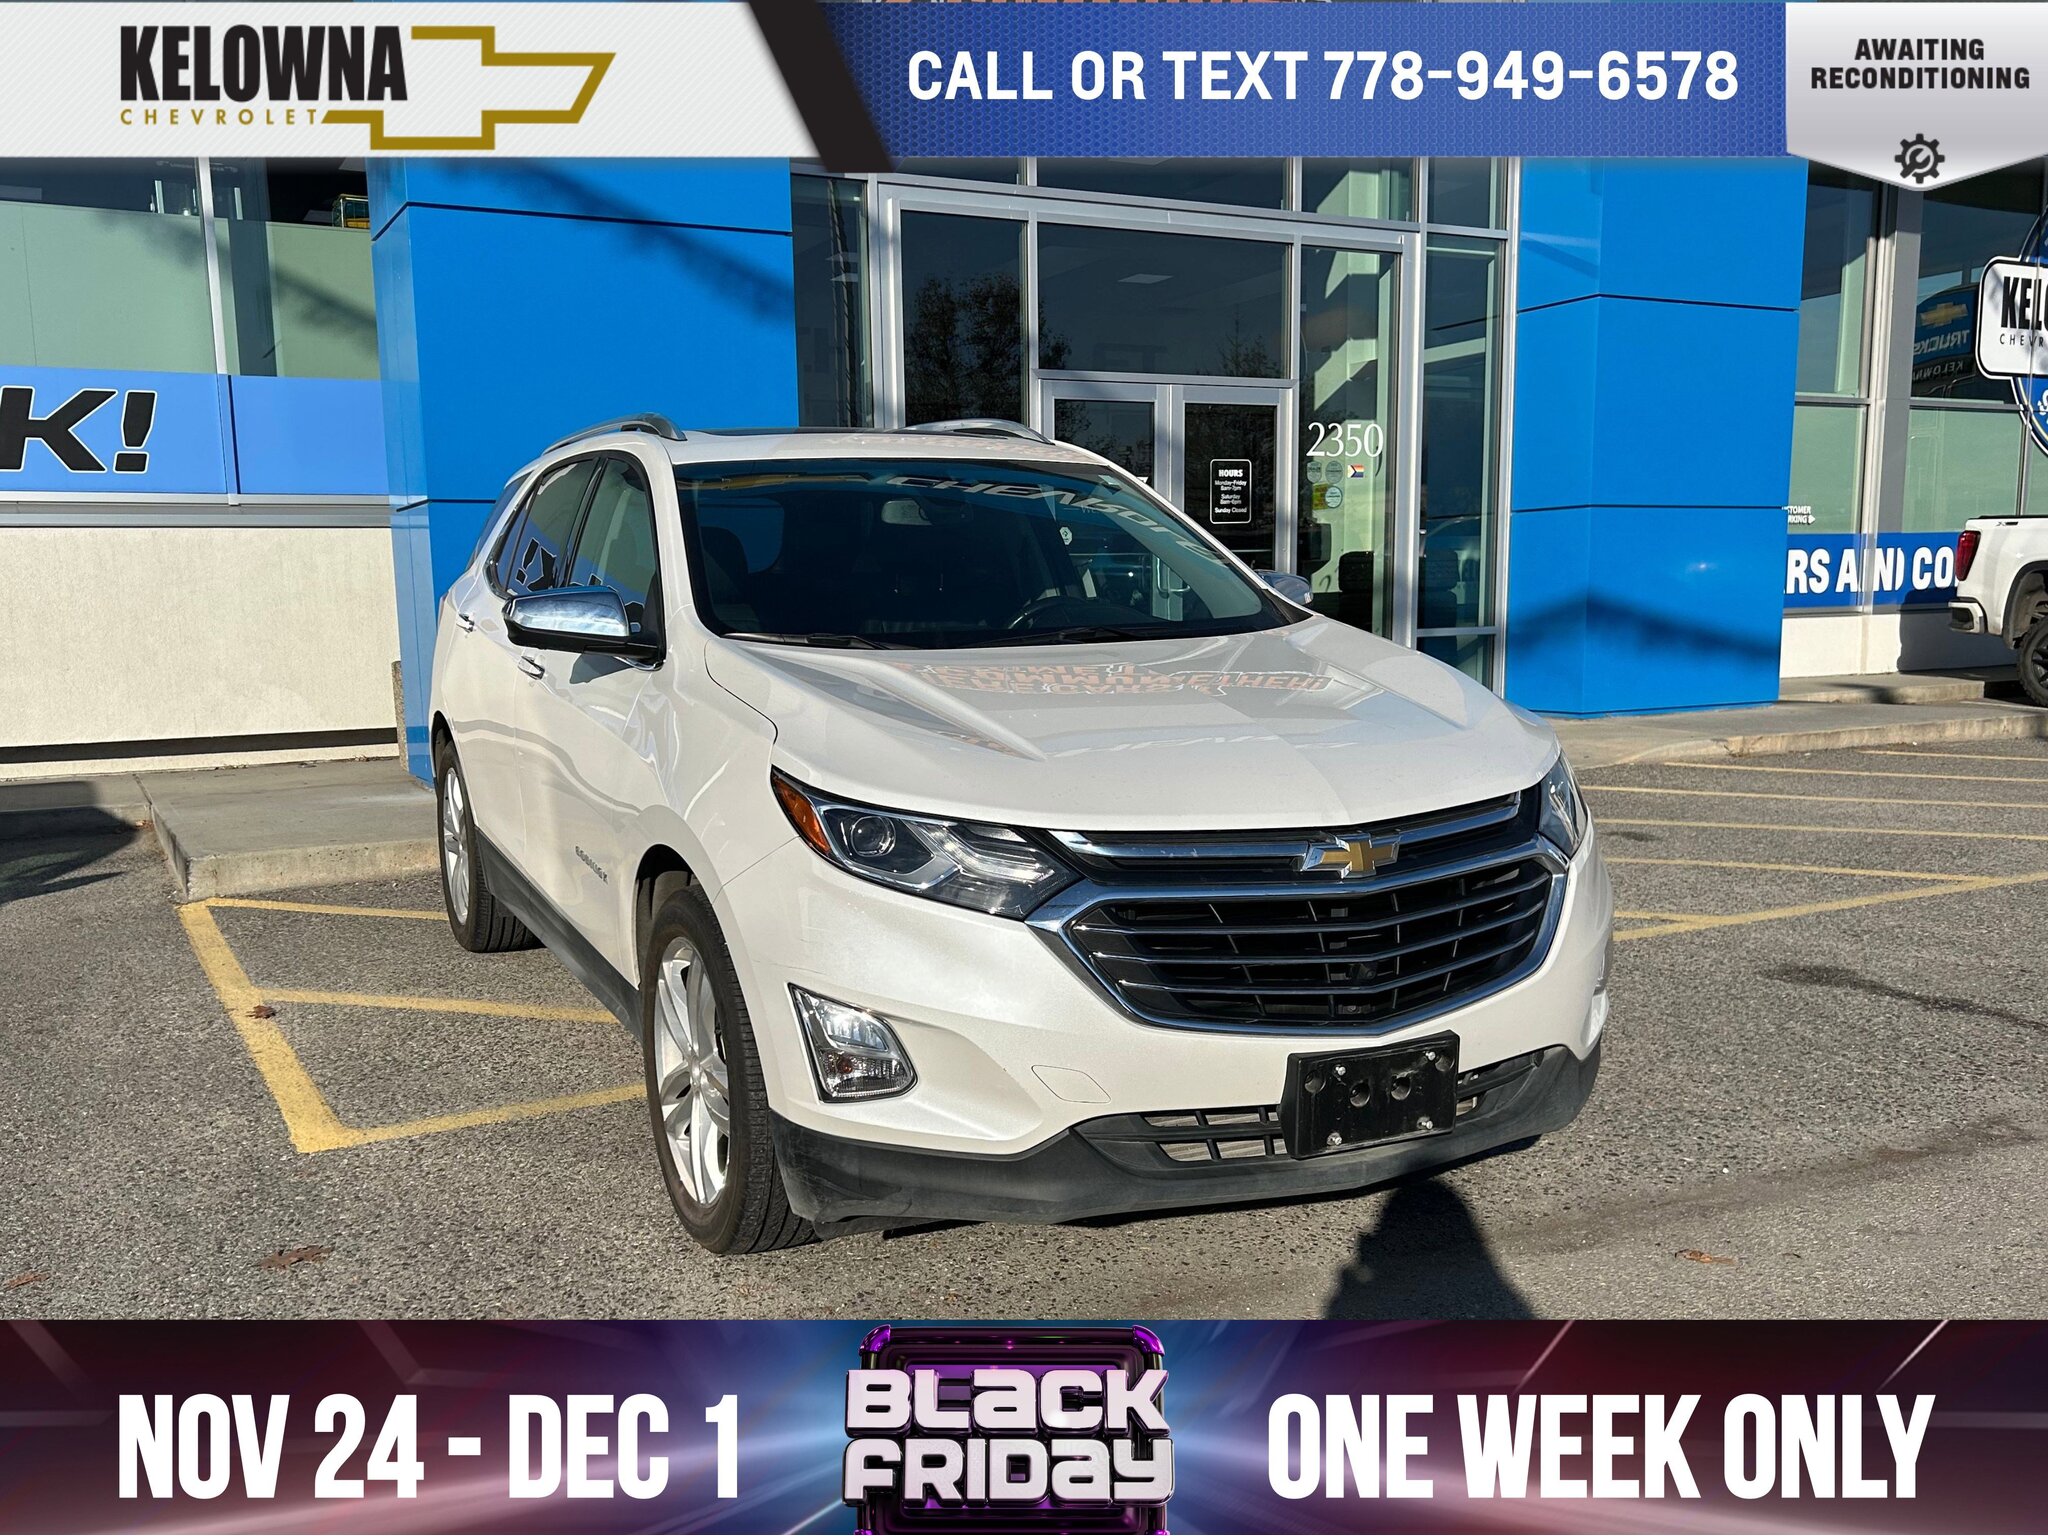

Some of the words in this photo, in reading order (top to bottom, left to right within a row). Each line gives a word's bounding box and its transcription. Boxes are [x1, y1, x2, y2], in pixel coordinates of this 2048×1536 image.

[0, 385, 157, 474] K!
[1306, 422, 1384, 457] 2350
[1218, 469, 1243, 477] HOURS
[1784, 548, 1831, 595] RS
[1912, 547, 1958, 591] CO
